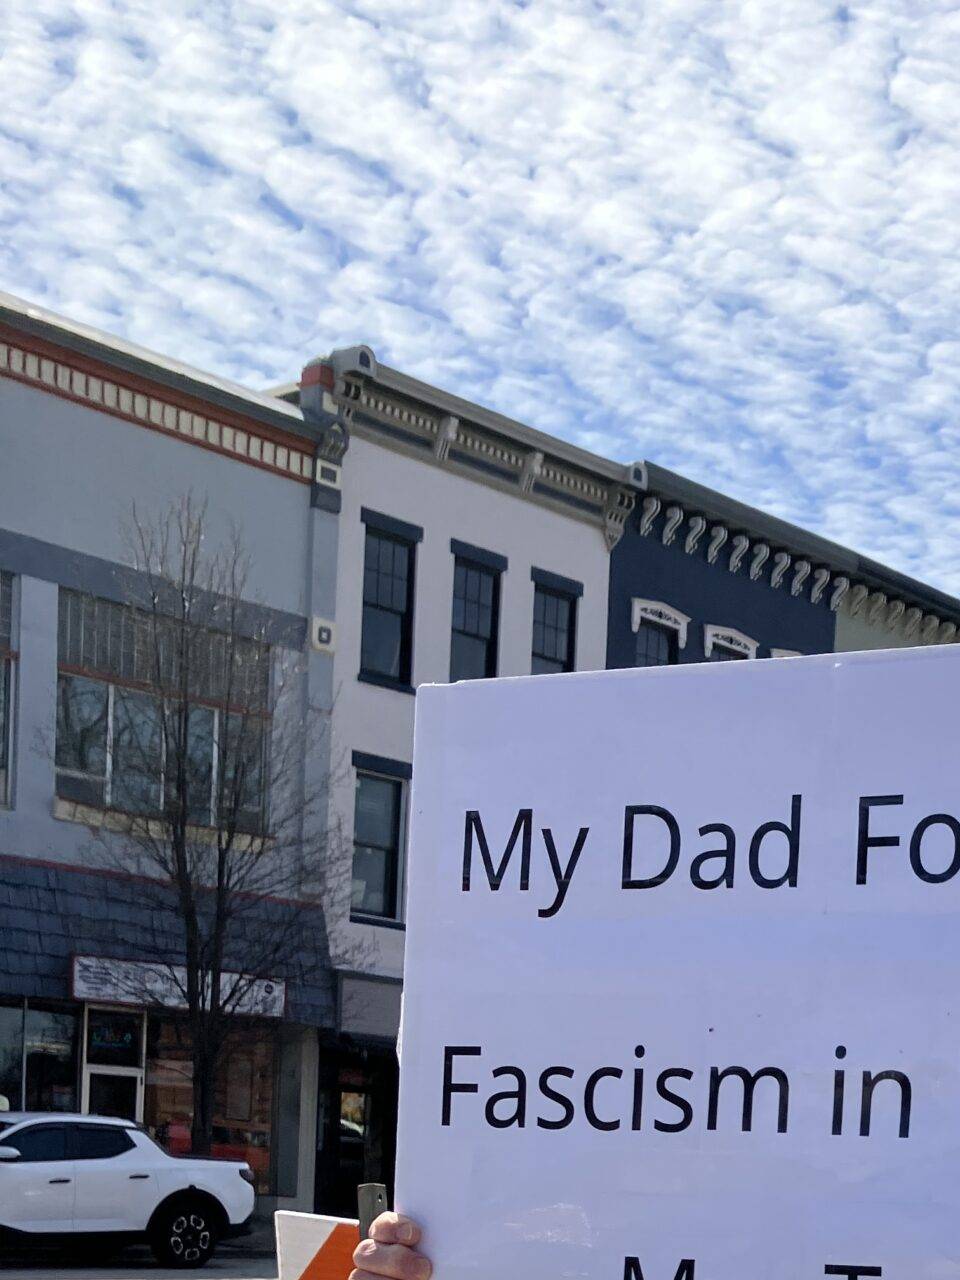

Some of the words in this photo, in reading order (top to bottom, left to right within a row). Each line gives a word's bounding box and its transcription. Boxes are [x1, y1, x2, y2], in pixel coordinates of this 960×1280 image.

[460, 807, 591, 920] My
[620, 793, 803, 892] Dad
[440, 1043, 791, 1135] Fascism
[830, 1044, 913, 1140] in
